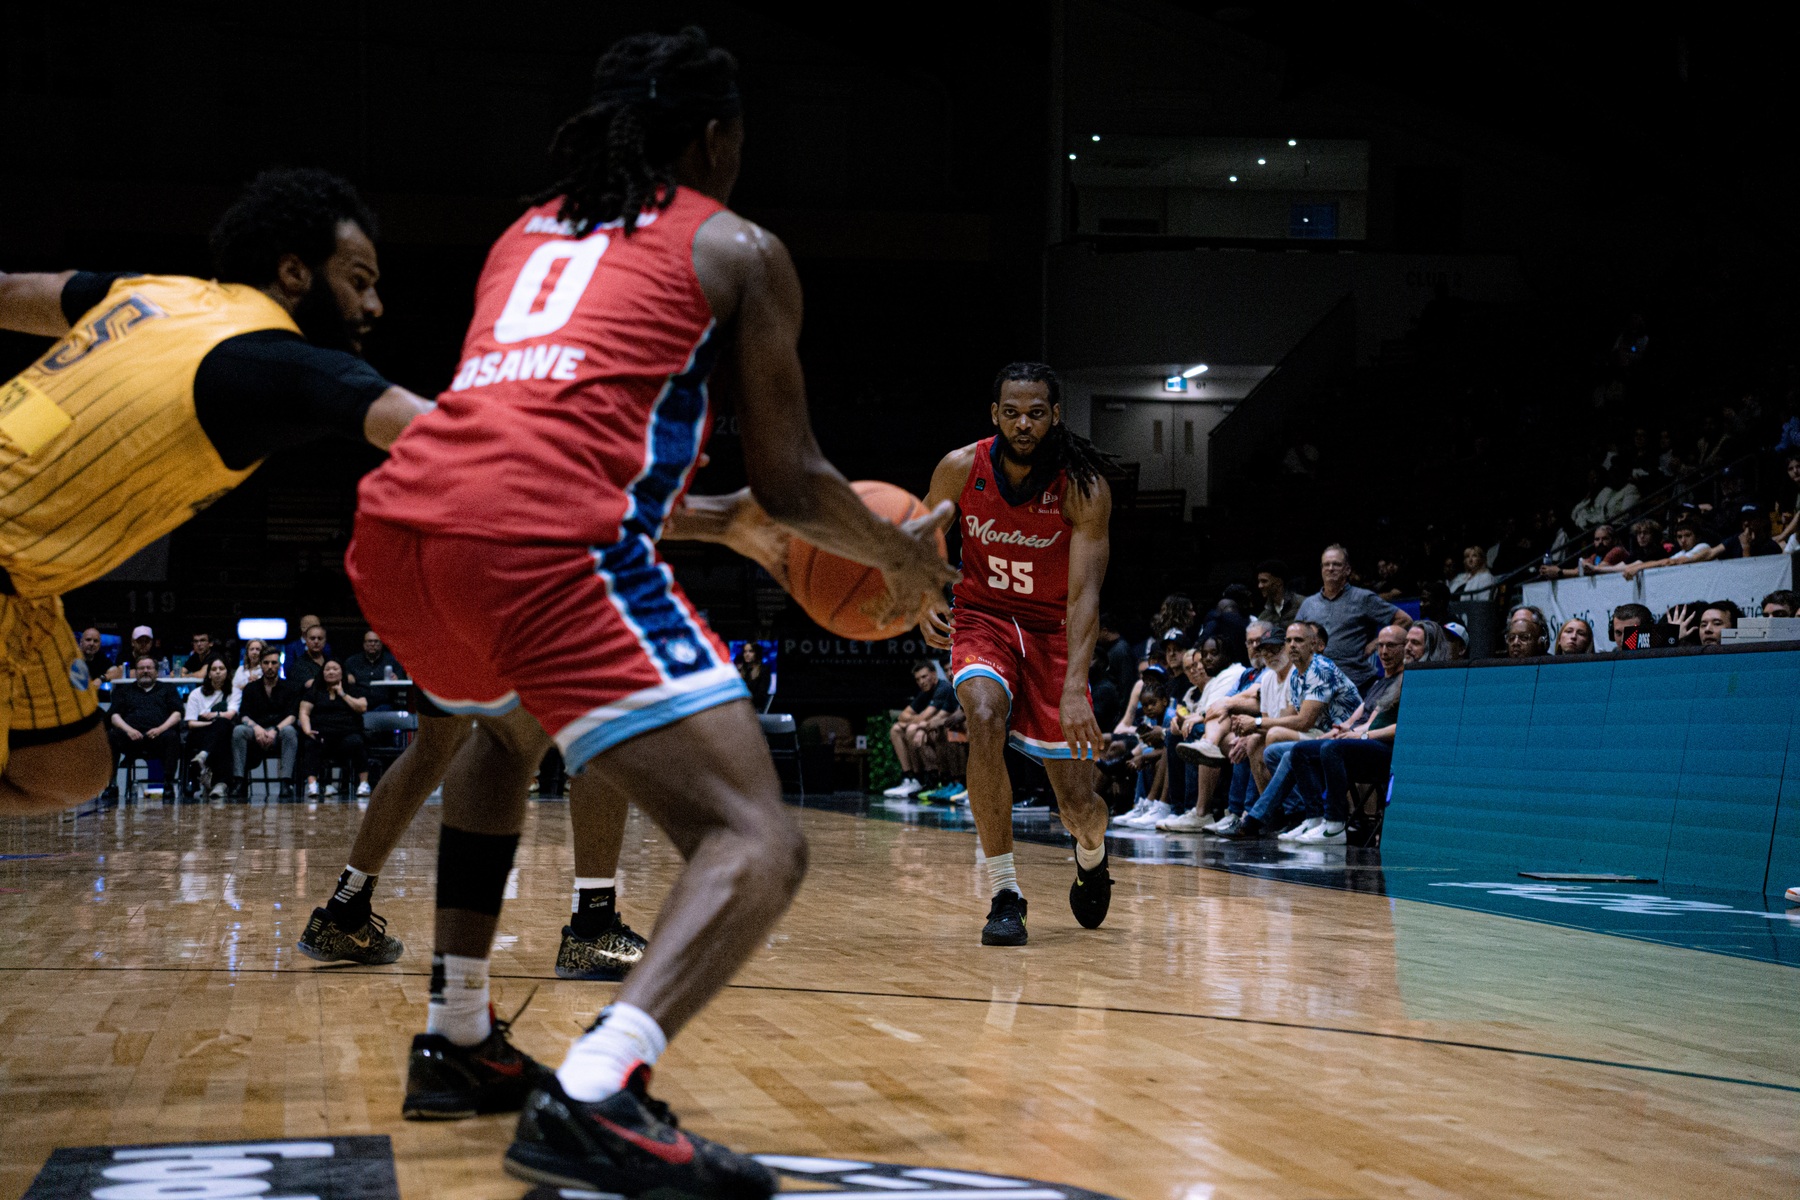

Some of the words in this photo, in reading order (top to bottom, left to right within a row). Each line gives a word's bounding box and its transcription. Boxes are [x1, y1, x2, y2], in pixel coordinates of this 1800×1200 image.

[494, 234, 610, 343] 0
[451, 345, 586, 391] OSAWE
[966, 515, 1062, 548] Montréal
[988, 555, 1033, 594] 55
[126, 590, 176, 613] 119
[784, 639, 877, 655] POULET
[977, 655, 992, 666] Sun
[992, 662, 1005, 674] Life
